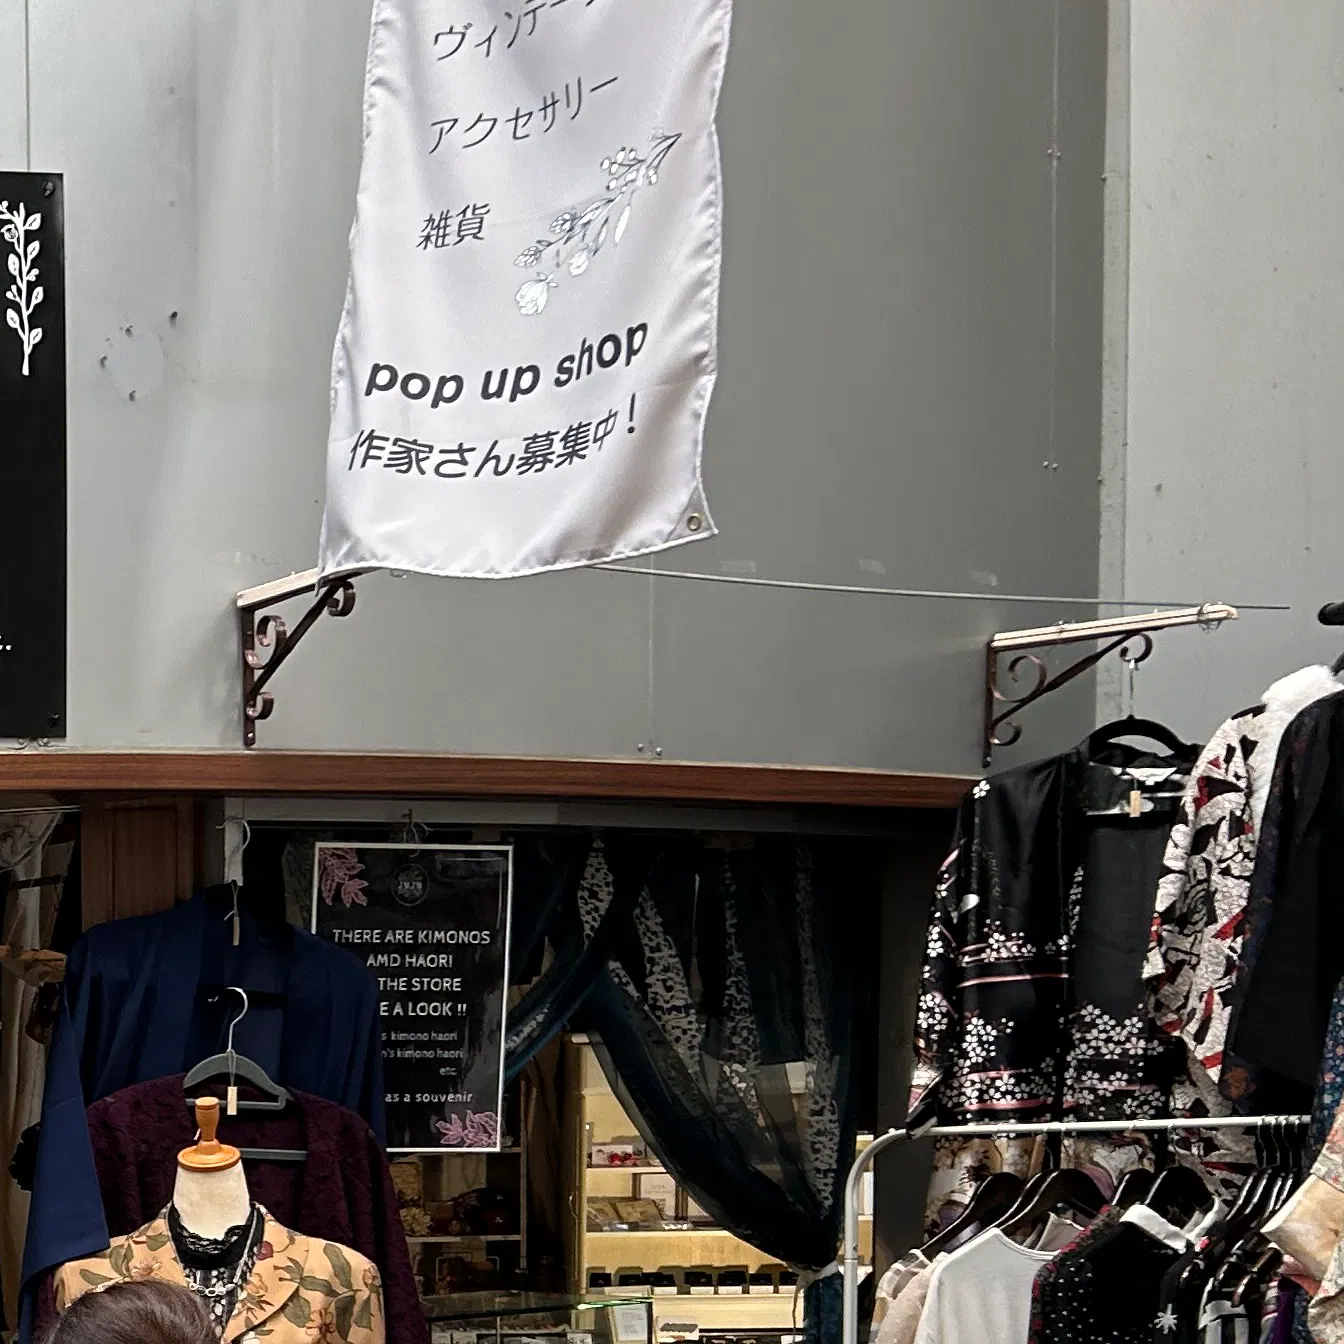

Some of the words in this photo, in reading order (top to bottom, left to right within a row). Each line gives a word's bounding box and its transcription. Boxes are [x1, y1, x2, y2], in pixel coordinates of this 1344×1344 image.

[428, 76, 619, 155] アクセサリー
[416, 202, 491, 250] 雑貨
[364, 362, 464, 409] pop
[480, 364, 541, 402] up
[554, 322, 648, 388] shop
[333, 929, 382, 943] THERE
[384, 929, 415, 943] ARE
[417, 930, 491, 944] KIMONOS
[366, 953, 401, 967] AMD
[405, 954, 453, 968] HAORI
[377, 977, 408, 991] THE
[411, 977, 462, 991] STORE
[392, 1002, 404, 1016] A
[407, 1002, 453, 1017] LOOK
[384, 1093, 400, 1103] as
[403, 1093, 411, 1103] a
[415, 1091, 474, 1103] souvenir
